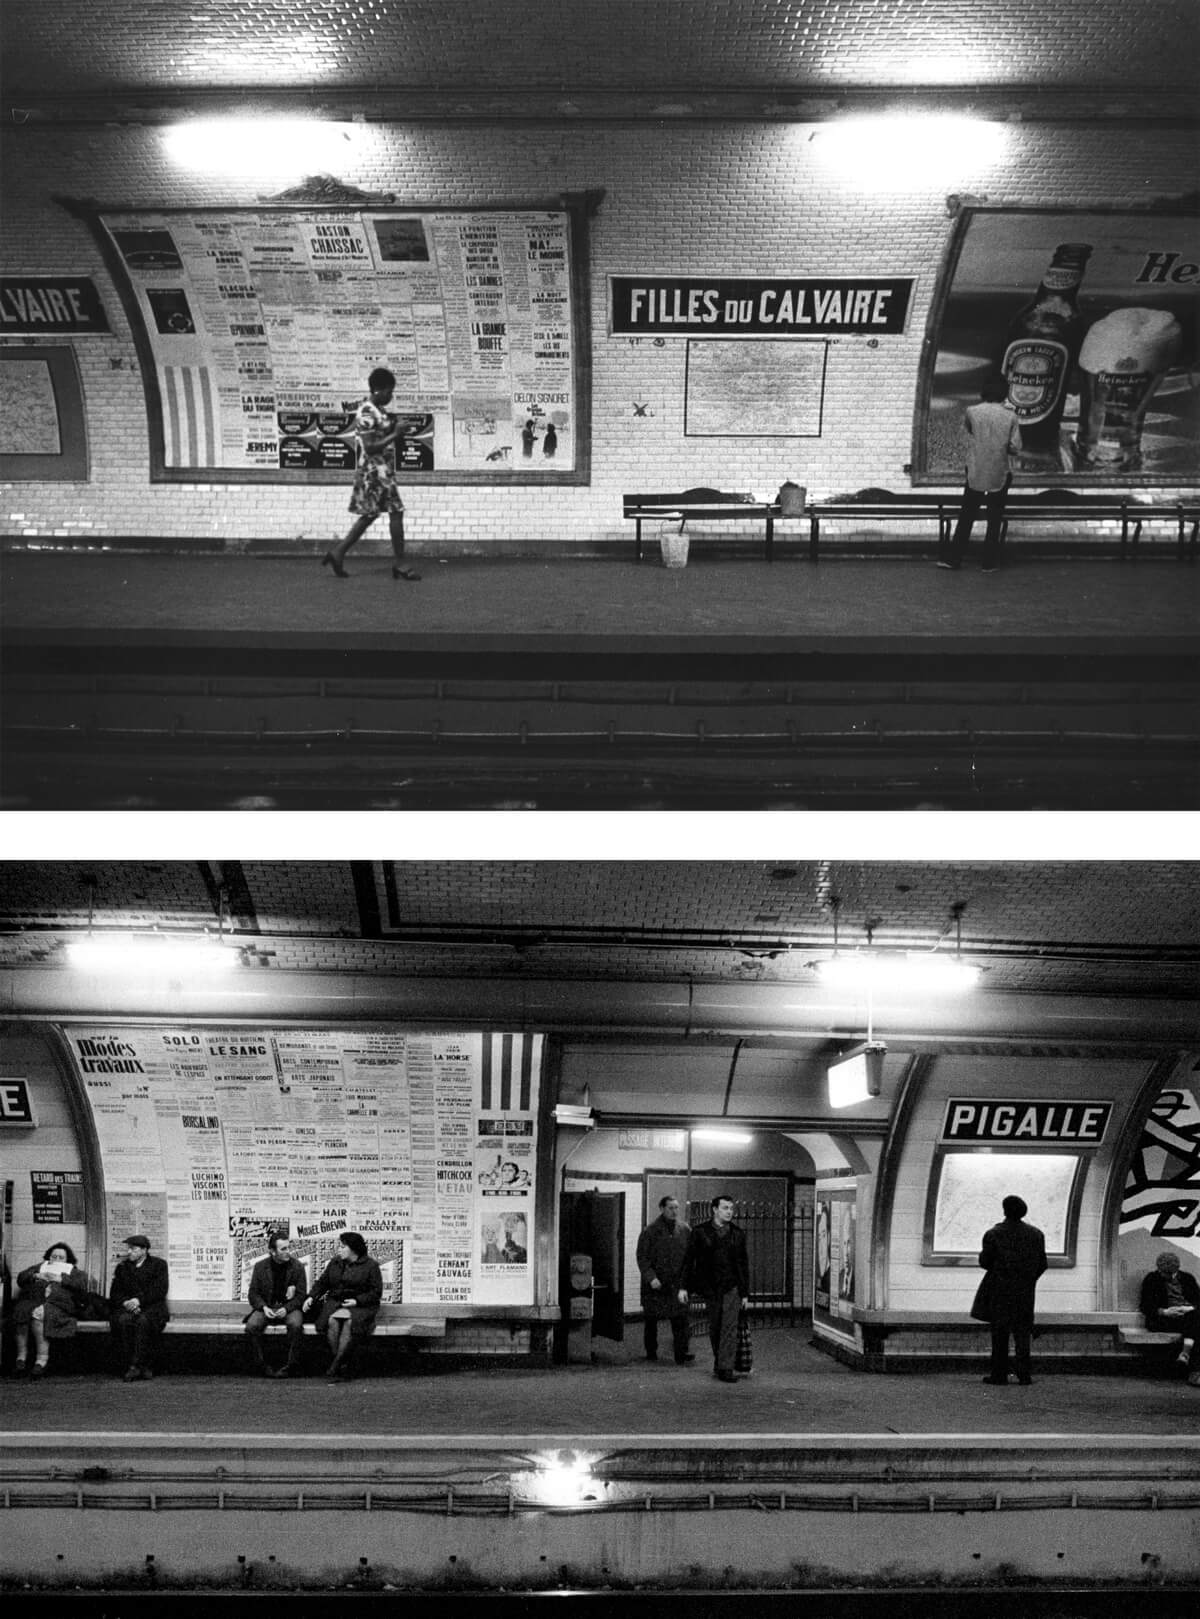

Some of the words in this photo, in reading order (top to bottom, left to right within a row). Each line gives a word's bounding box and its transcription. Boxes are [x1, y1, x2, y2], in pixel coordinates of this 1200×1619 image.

[316, 226, 350, 237] GASTON
[311, 239, 364, 253] CHAISSAC
[1135, 252, 1200, 285] He
[630, 288, 719, 323] FILLES
[724, 300, 753, 323] DU
[759, 289, 892, 324] CALVAIRE
[471, 323, 480, 335] LA
[514, 393, 535, 403] DELON
[537, 393, 569, 403] SIGNORET
[246, 442, 277, 452] JEREMY
[162, 1036, 200, 1045] SOLO
[77, 1040, 136, 1057] Modes
[210, 1046, 227, 1056] LE
[230, 1046, 266, 1055] SANG
[80, 1058, 145, 1073] travaux
[182, 1115, 219, 1128] BORSALINO
[950, 1105, 1104, 1137] PIGALLE
[192, 1173, 224, 1181] LUCHINO
[437, 1171, 472, 1180] HITCHCOCK
[192, 1191, 202, 1200] LES
[204, 1191, 227, 1200] DAMNES
[323, 1209, 347, 1217] HAIR
